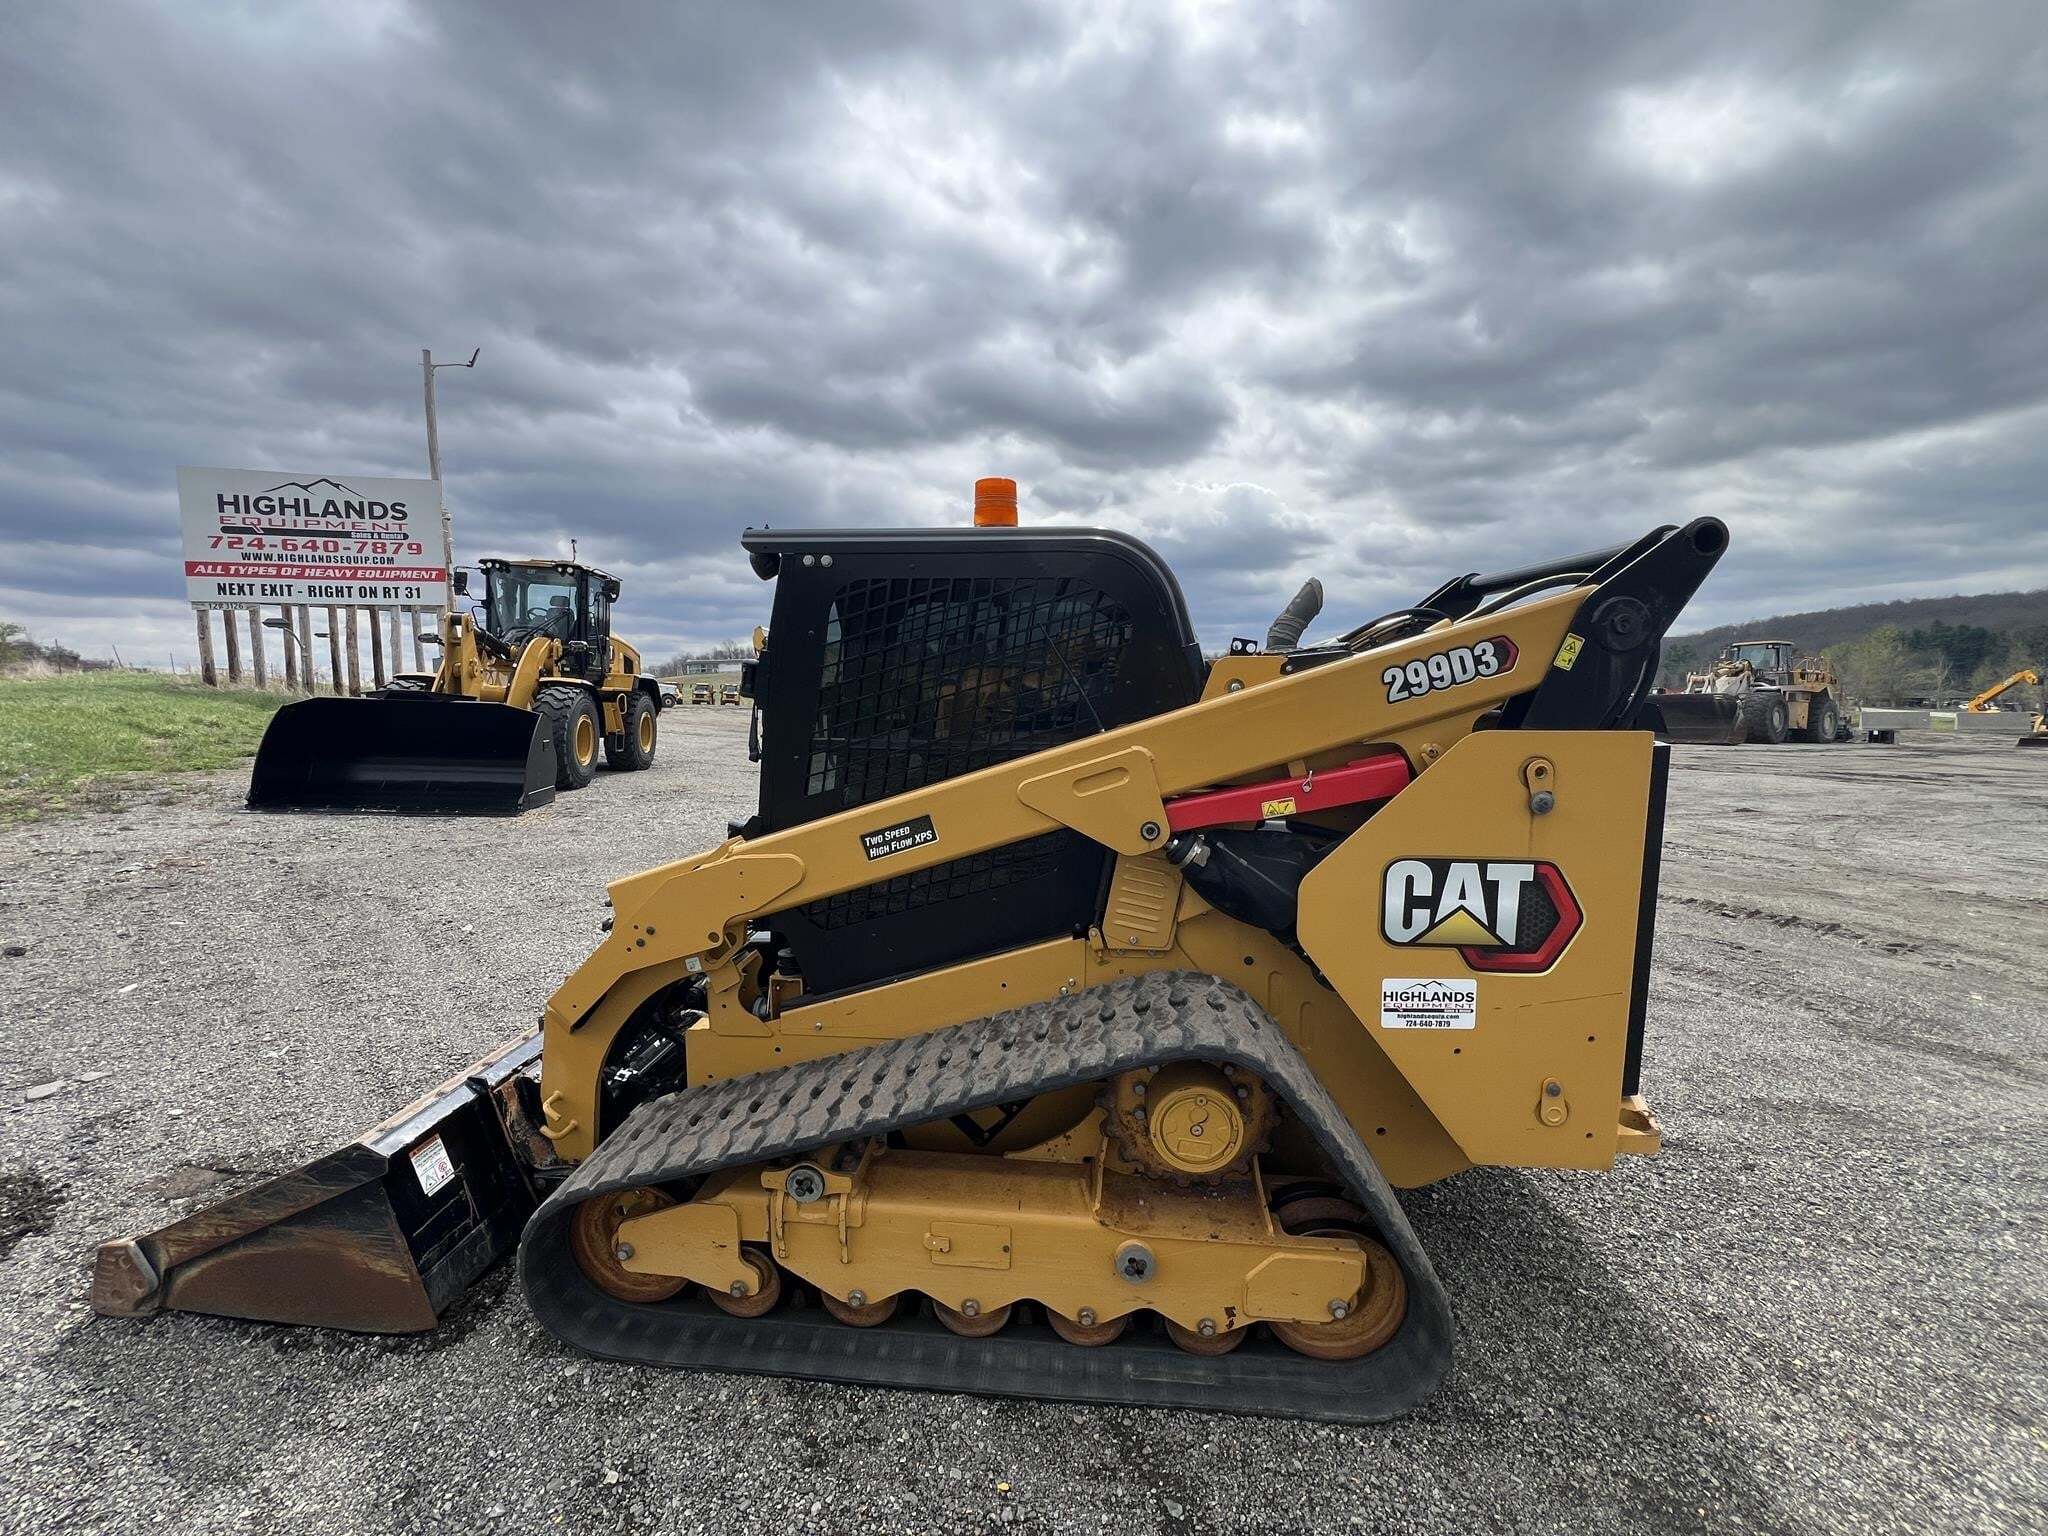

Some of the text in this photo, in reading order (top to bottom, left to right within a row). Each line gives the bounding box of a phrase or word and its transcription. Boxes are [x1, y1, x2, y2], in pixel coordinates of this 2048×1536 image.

[217, 494, 408, 521] HIGHLANDS
[219, 516, 408, 534] EQUIPMENT
[208, 536, 423, 555] 724-640-7879
[241, 552, 395, 565] WWW.HIGHLANDSEQUIP.COM
[194, 564, 439, 579] ALL TYPES OF HEAVY EQUIPMENT
[217, 583, 255, 596] NEXT
[260, 584, 293, 597] EXIT
[308, 585, 353, 598] RIGHT
[358, 586, 378, 598] ON
[383, 586, 400, 599] RT
[404, 587, 421, 599] 31
[1383, 641, 1499, 703] 299D3
[915, 831, 932, 844] XPS
[1384, 860, 1535, 946] CAT
[1383, 991, 1475, 1002] HIGHLANDS
